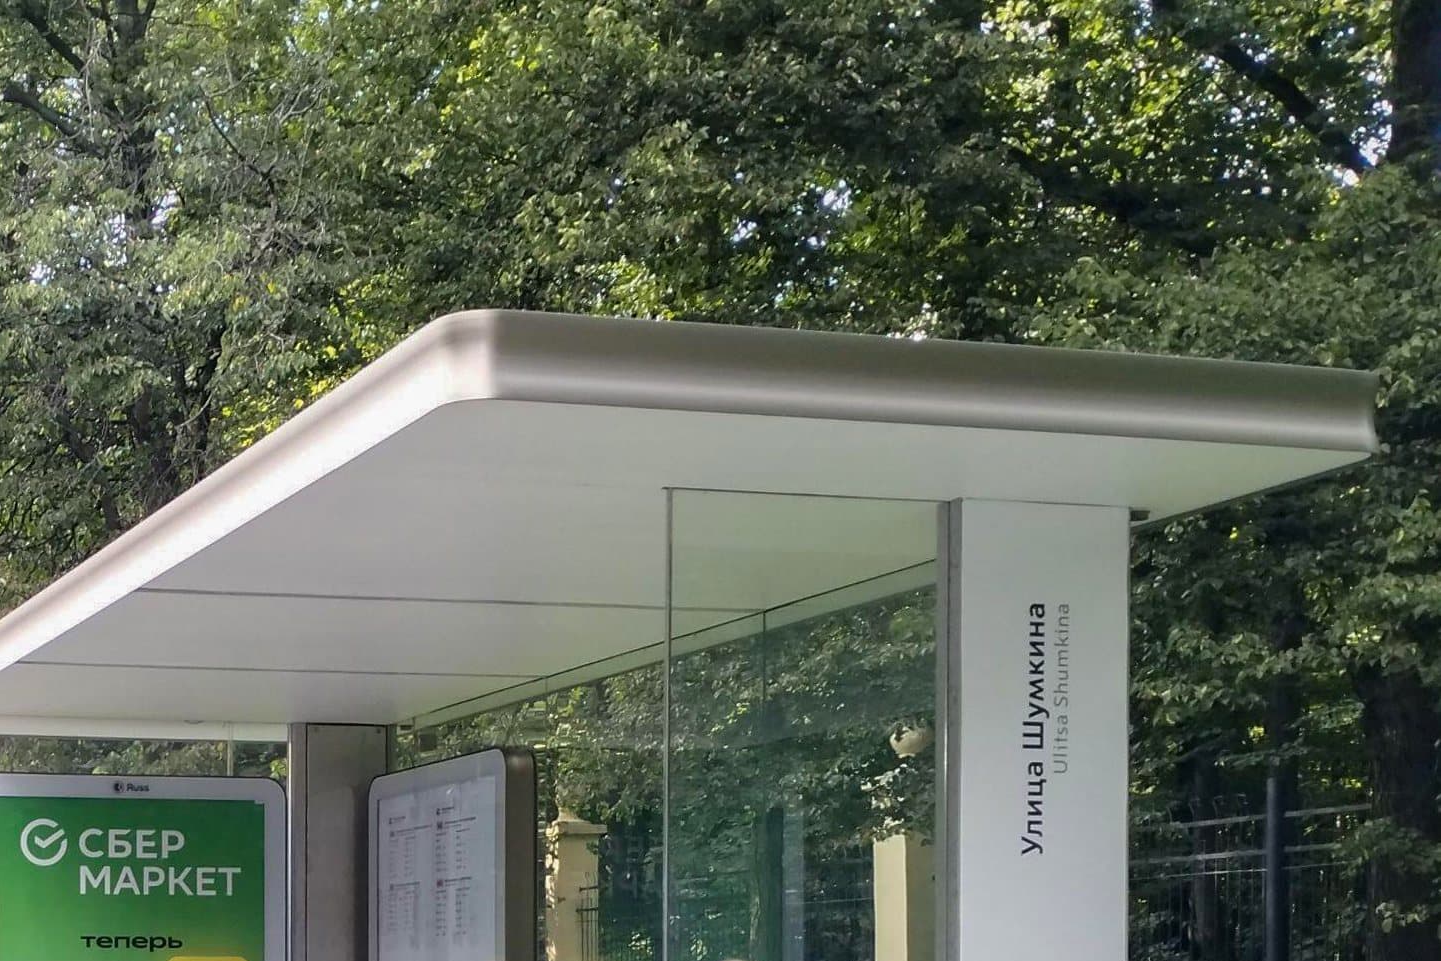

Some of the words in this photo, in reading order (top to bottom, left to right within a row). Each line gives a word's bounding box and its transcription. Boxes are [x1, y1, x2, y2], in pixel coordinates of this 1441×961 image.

[1022, 602, 1050, 750] Шумкина
[1053, 603, 1070, 708] Shumkina
[1053, 714, 1069, 775] Ulitsa
[1021, 761, 1047, 856] Улица
[78, 828, 185, 860] СБЕР
[78, 866, 241, 896] МАРКЕТ
[80, 935, 183, 953] теперь
